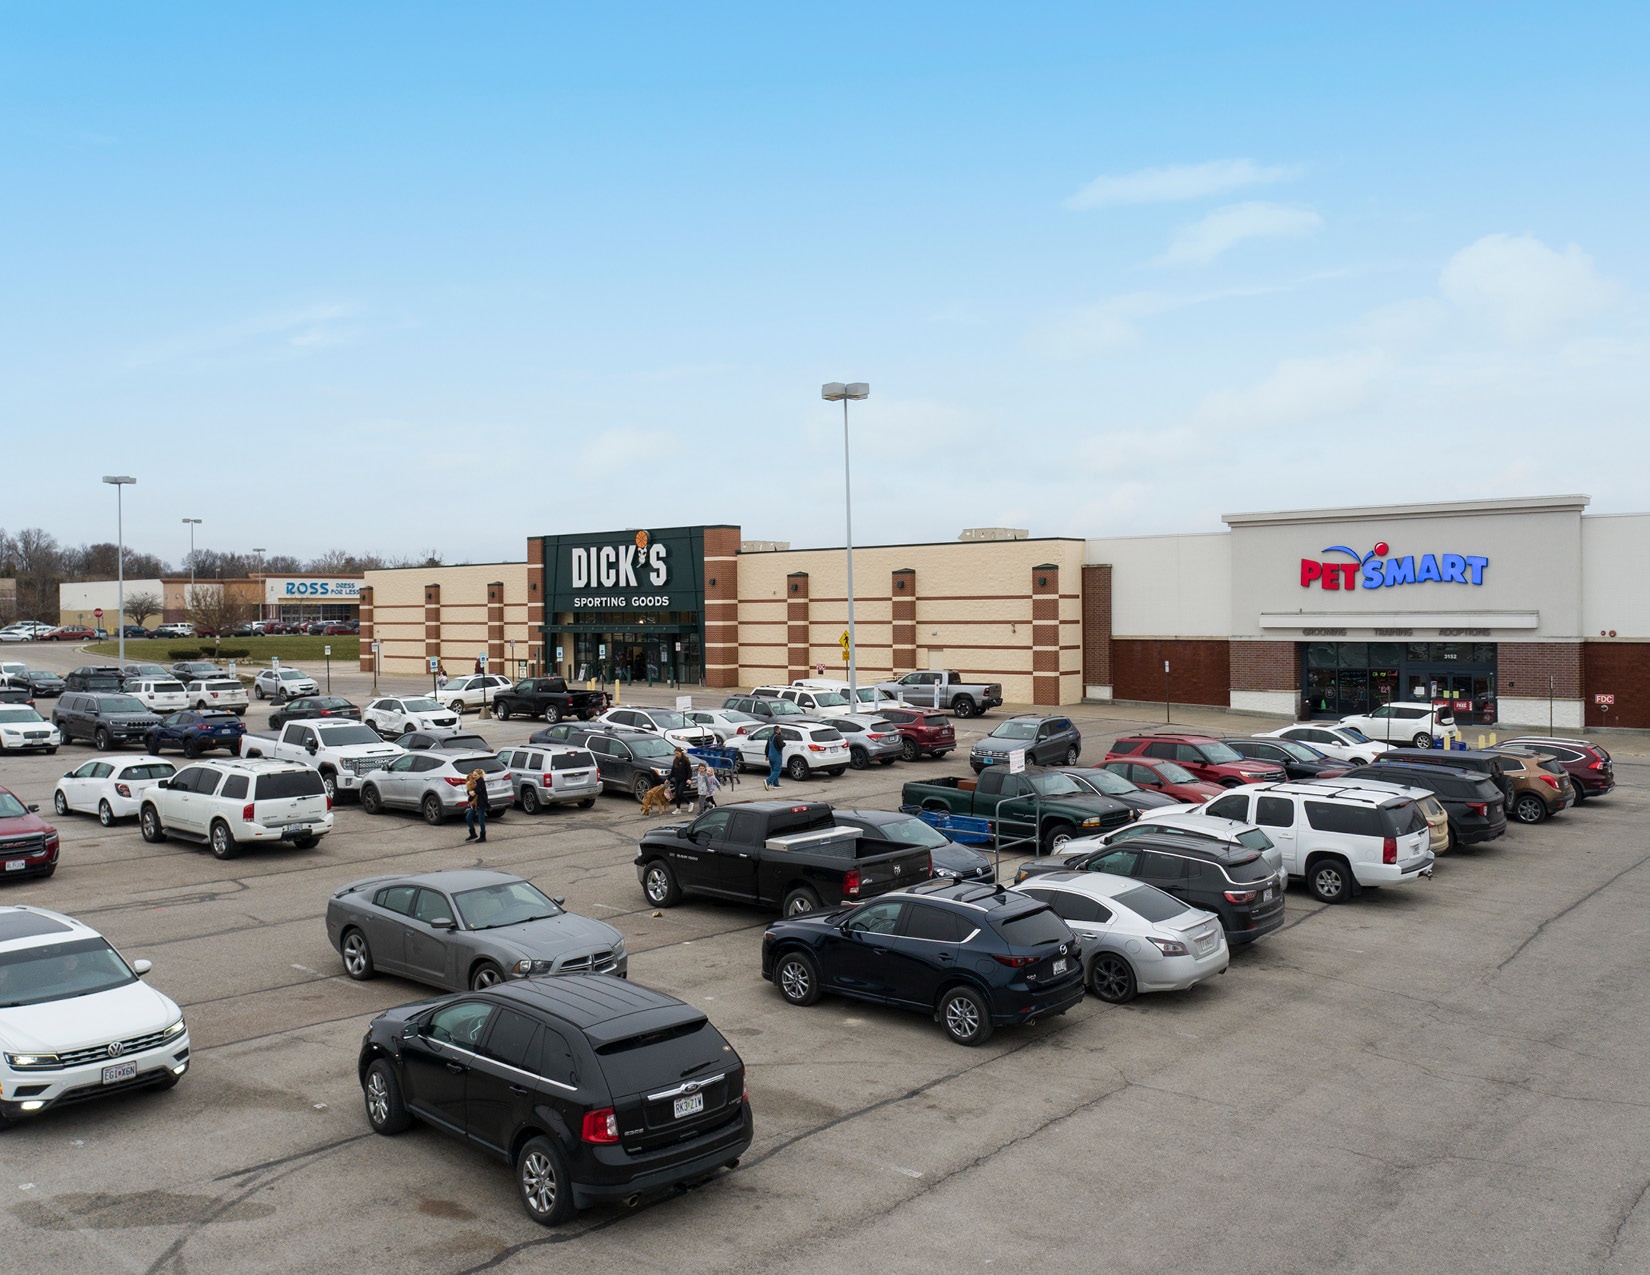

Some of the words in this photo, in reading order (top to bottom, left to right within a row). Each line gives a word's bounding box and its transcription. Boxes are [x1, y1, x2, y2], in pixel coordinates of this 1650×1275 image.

[572, 543, 667, 588] DICK'S
[286, 582, 329, 595] ROSS
[574, 597, 626, 607] SPORTING
[631, 596, 670, 606] GOODS
[1303, 628, 1347, 636] GROOMING
[1373, 628, 1413, 636] TRAINING
[1438, 628, 1491, 636] ADOPTIONS
